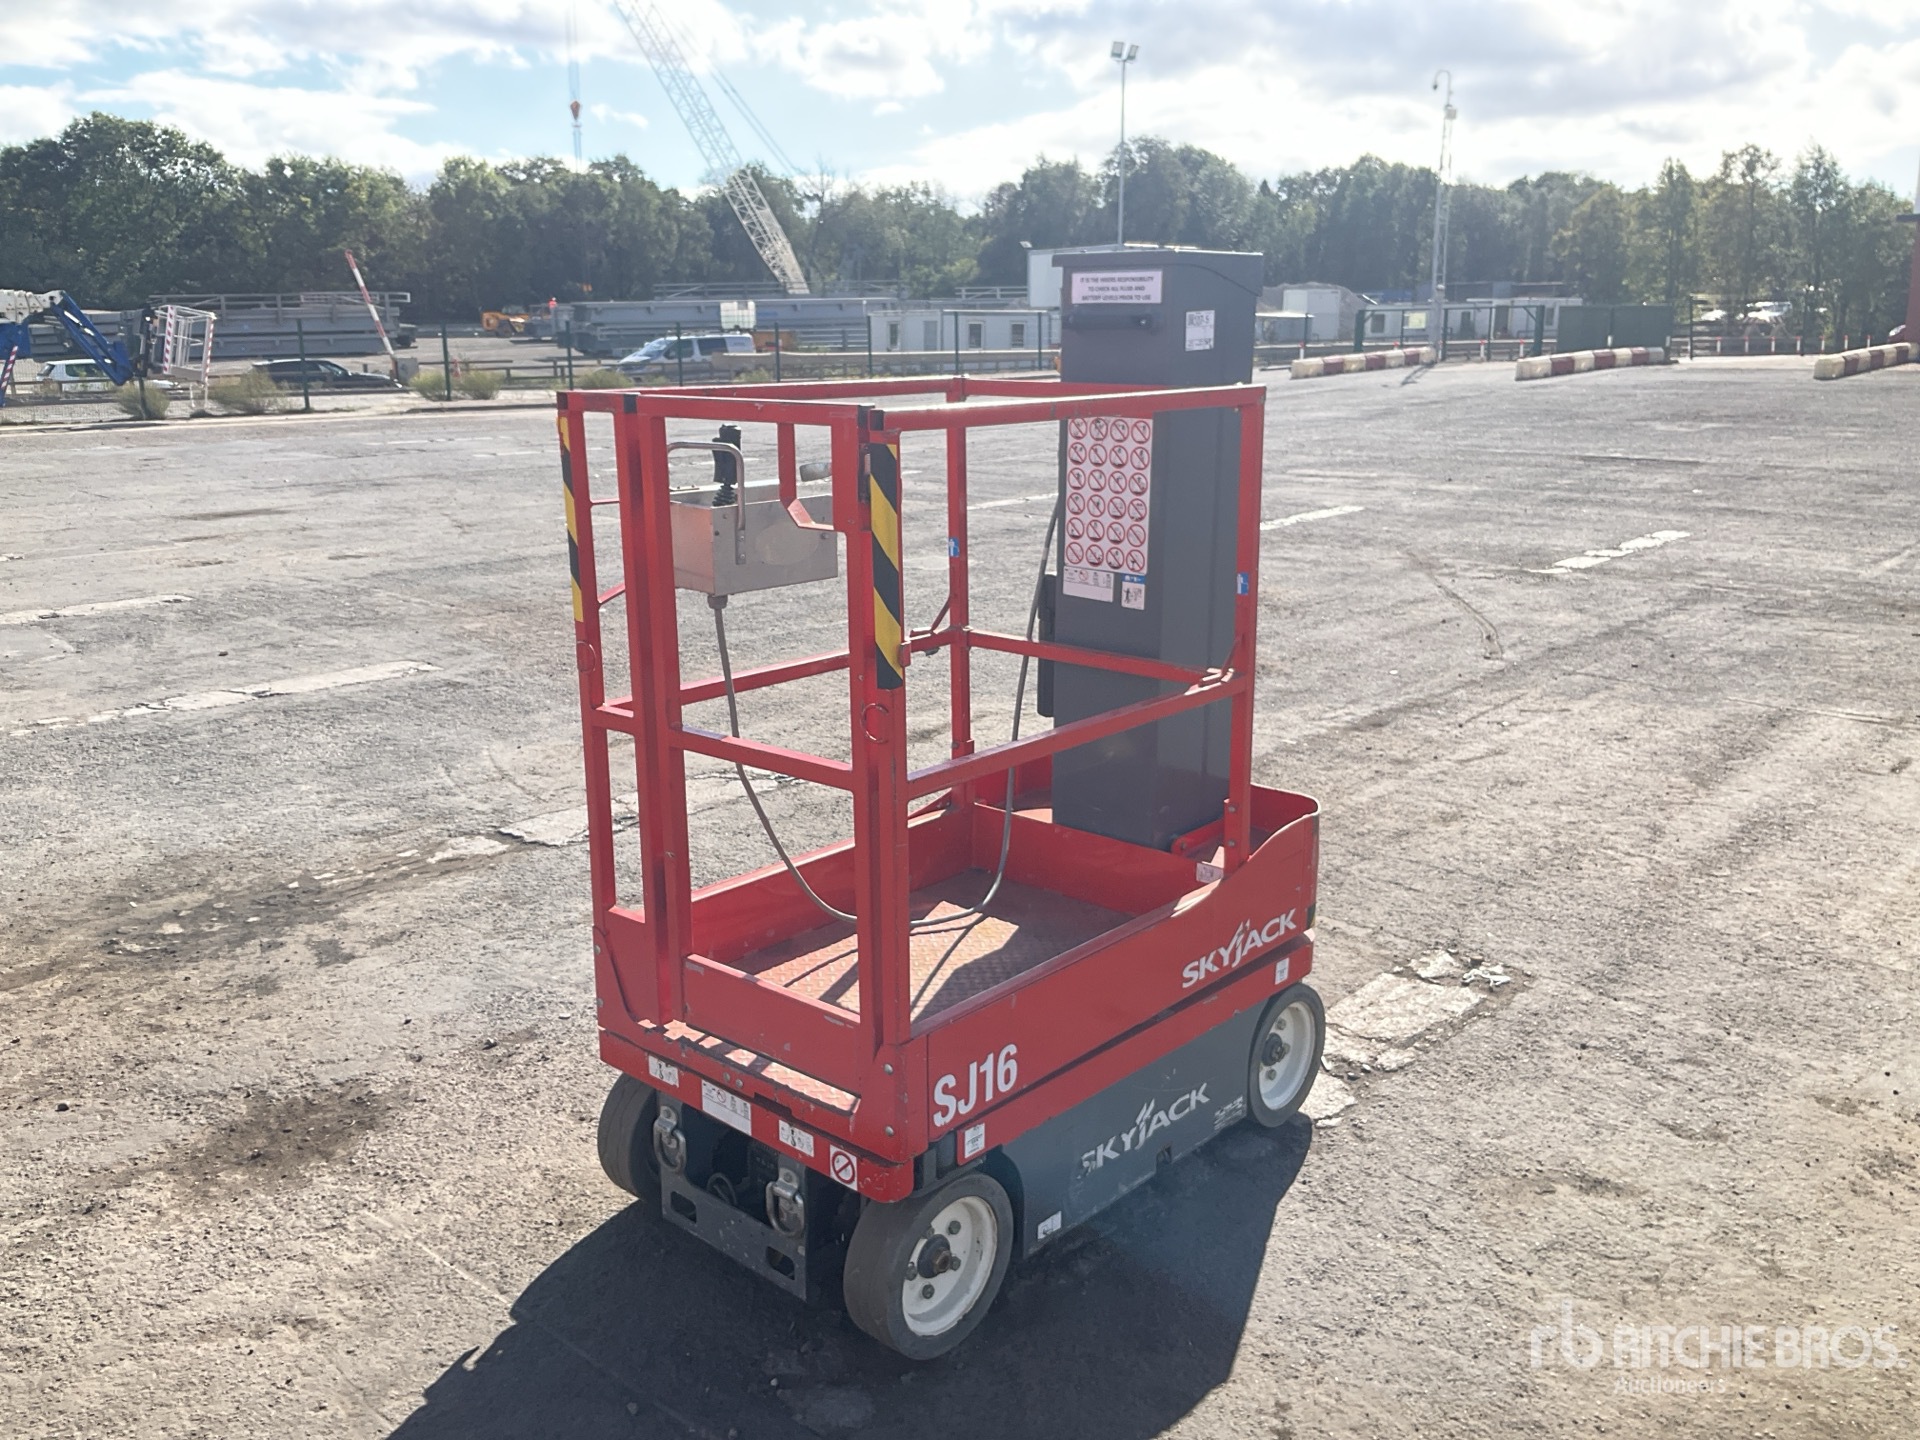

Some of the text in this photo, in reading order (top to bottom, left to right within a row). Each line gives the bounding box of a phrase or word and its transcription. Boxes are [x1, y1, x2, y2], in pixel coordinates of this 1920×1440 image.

[1182, 908, 1296, 988] SKYJACK
[933, 1043, 1018, 1127] SJ16
[1079, 1082, 1210, 1173] SKYJACK
